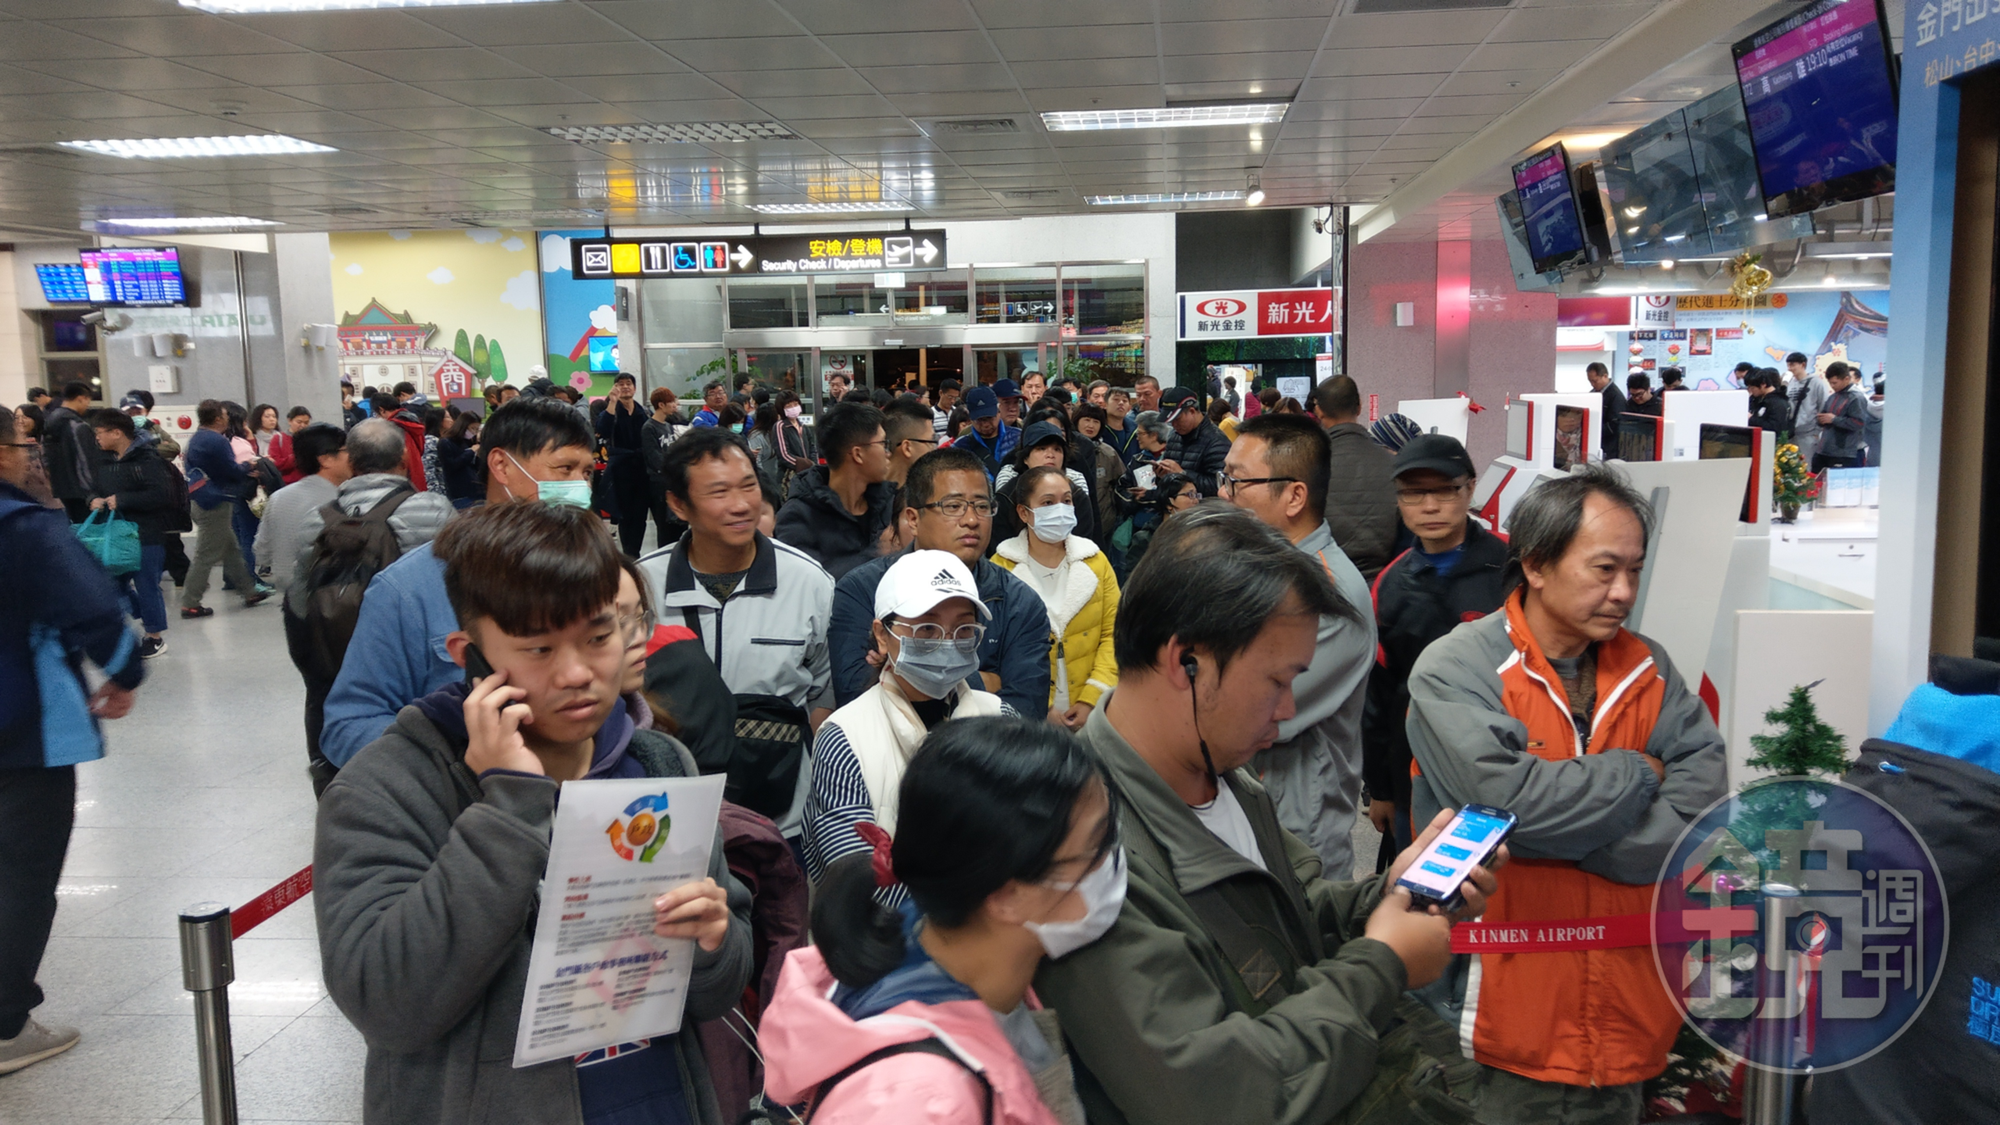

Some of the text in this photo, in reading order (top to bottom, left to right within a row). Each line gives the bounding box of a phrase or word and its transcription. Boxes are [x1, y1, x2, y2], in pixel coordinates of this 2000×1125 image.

[1916, 0, 2000, 47] 金門出
[1806, 49, 1827, 71] 19:10
[809, 239, 883, 257] 安檢/登機
[762, 259, 797, 273] Security
[799, 259, 827, 270] Check
[834, 256, 881, 271] Departures
[1215, 301, 1228, 315] 光
[1197, 319, 1246, 332] 新光金控
[931, 579, 962, 587] adidas
[1469, 925, 1606, 943] KINMEN AIRPORT
[1972, 976, 2000, 1006] SU
